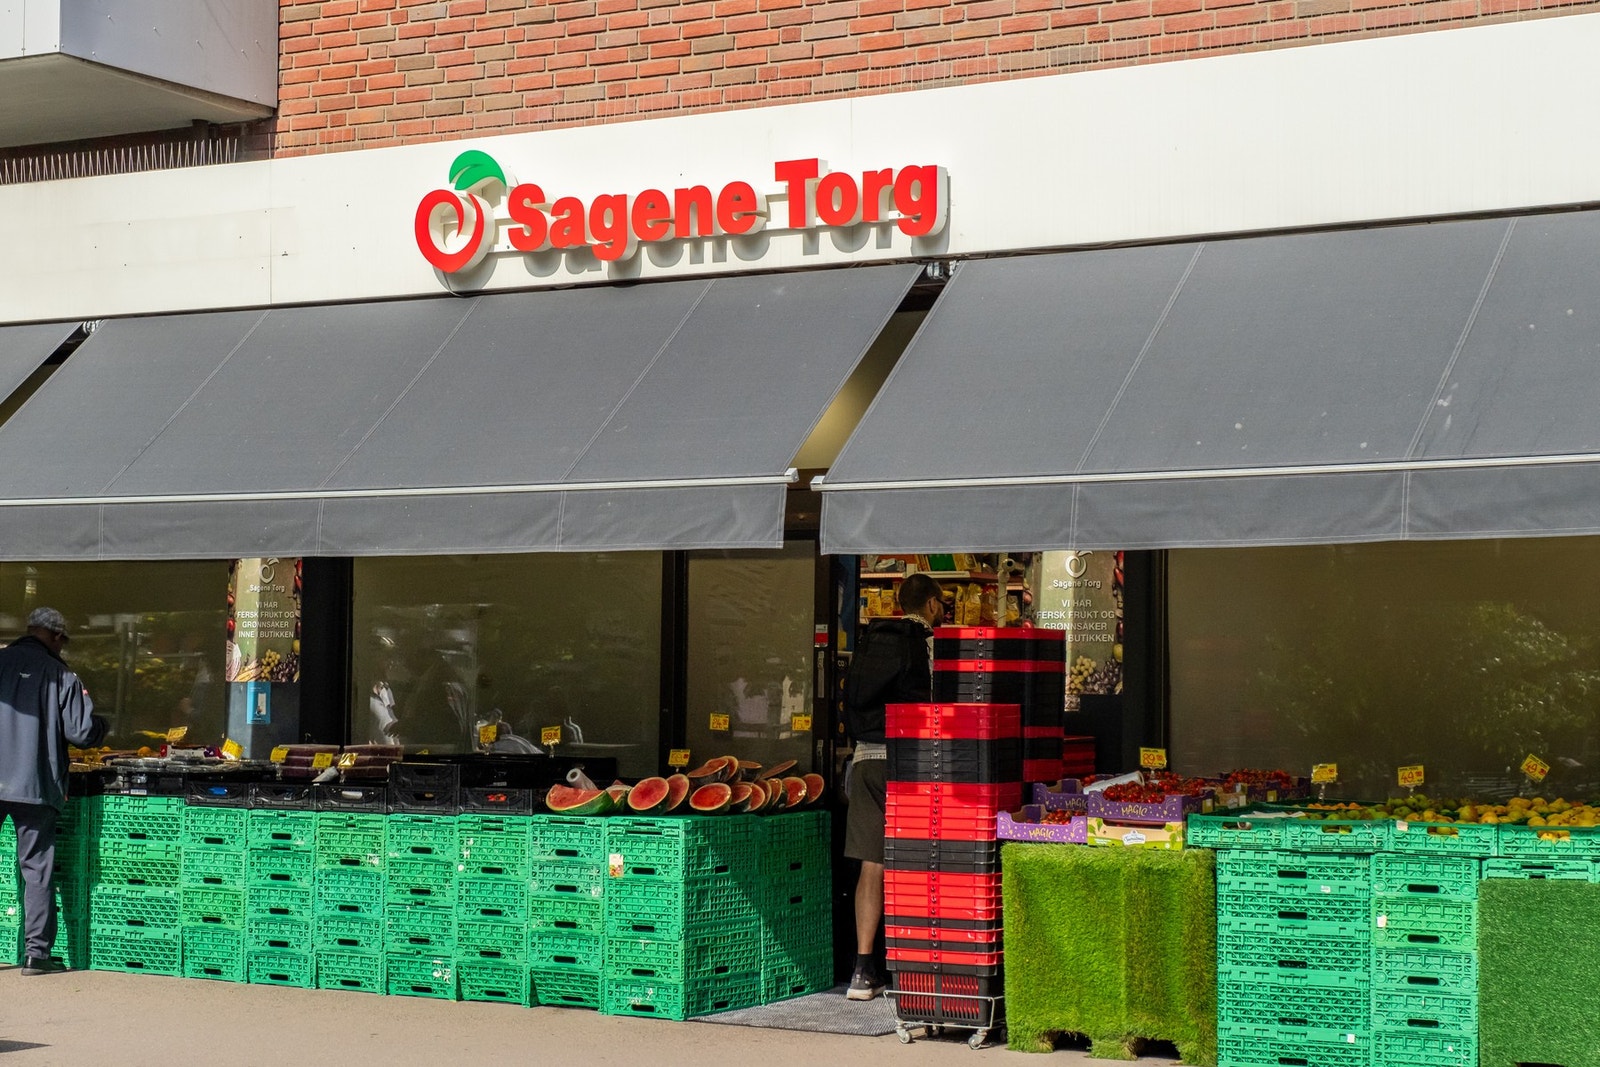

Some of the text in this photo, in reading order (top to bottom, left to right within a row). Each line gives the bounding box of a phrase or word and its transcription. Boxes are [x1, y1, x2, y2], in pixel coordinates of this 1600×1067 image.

[507, 157, 939, 262] Sagene Torg
[249, 584, 285, 593] Sagene Torg
[1053, 579, 1101, 589] Sagene Torg
[1061, 599, 1092, 607] VI HAR
[1036, 611, 1115, 619] FERSK FRUKT OG
[1044, 622, 1107, 630] GRØNNSAKER
[1068, 634, 1114, 642] BUTIKKEN
[1065, 798, 1088, 809] MAGIC
[1121, 804, 1148, 816] MAGIC
[1028, 827, 1055, 839] MAGIC
